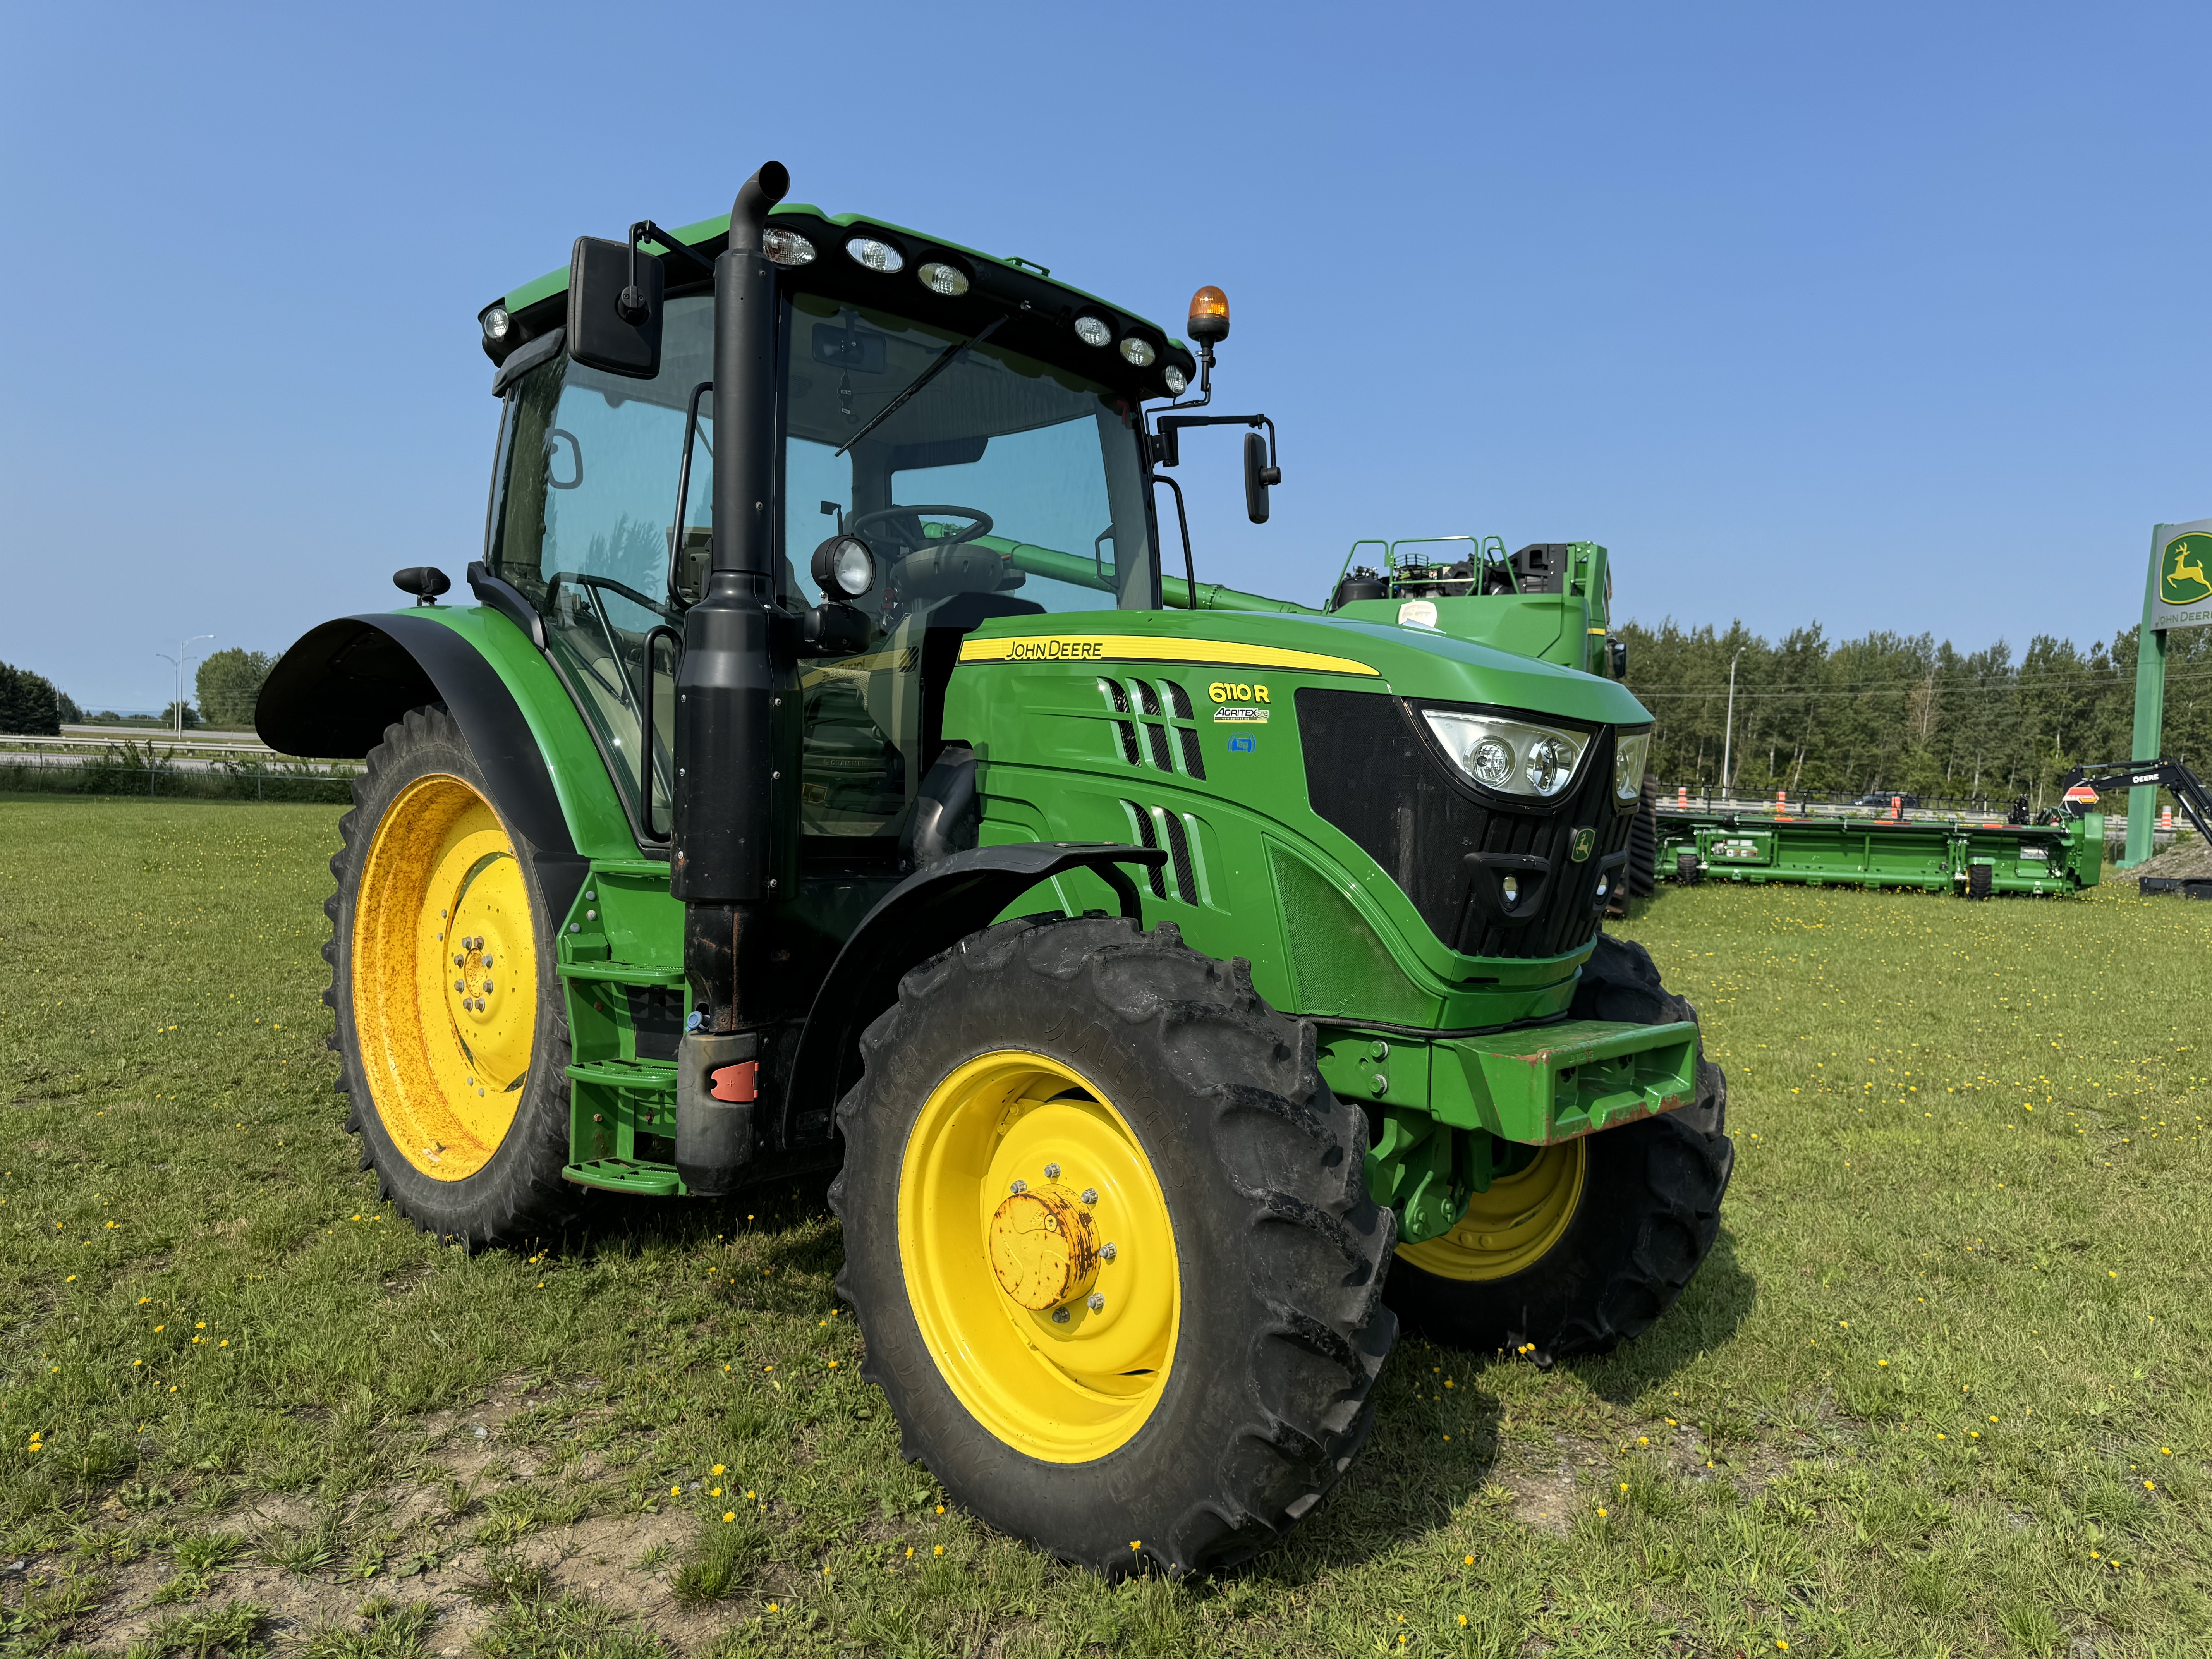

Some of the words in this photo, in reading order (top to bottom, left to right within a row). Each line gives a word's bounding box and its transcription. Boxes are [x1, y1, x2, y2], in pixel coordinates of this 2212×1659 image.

[2155, 614, 2179, 628] JOHN
[2180, 611, 2212, 622] DEER
[1006, 641, 1046, 657] JOHN
[1048, 640, 1103, 657] DEERE
[1215, 708, 1258, 716] AGRITEX
[2133, 773, 2159, 783] DEERE
